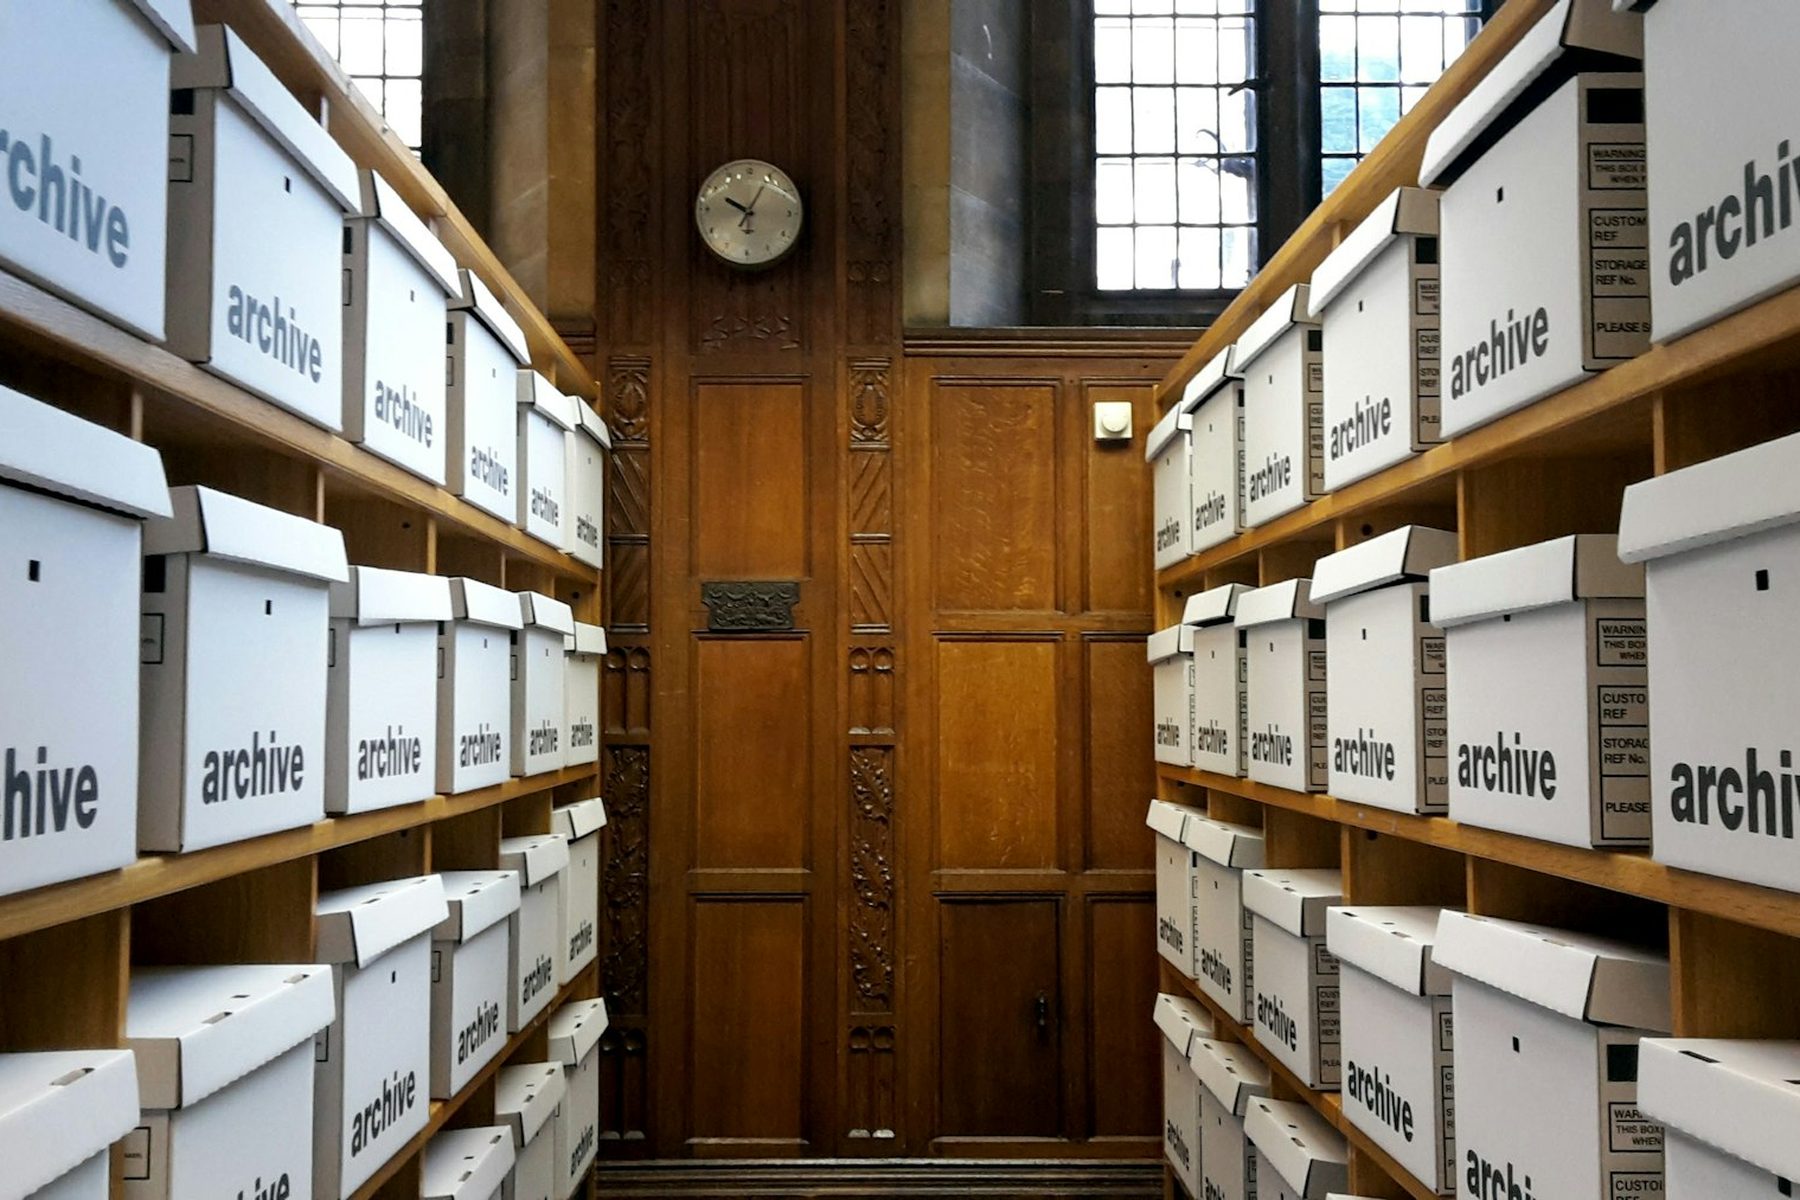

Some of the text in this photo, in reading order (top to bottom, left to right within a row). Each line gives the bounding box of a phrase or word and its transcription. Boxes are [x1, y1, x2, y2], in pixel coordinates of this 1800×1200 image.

[1595, 231, 1618, 241] REF
[1596, 275, 1618, 285] REF
[228, 284, 322, 384] archive
[1596, 322, 1640, 333] PLEASE
[1451, 307, 1550, 400] archive
[374, 379, 433, 450] archive
[1331, 395, 1392, 461] archive
[471, 445, 509, 497] archive
[1250, 452, 1291, 503] archive
[531, 486, 559, 527] archive
[1195, 490, 1226, 531] archive
[1156, 516, 1180, 551] archive
[530, 719, 559, 757] archive
[1198, 719, 1228, 756] archive
[1603, 709, 1627, 719] REF
[202, 731, 303, 805] archive
[358, 726, 420, 780] archive
[460, 723, 501, 767] archive
[1252, 724, 1292, 767] archive
[1335, 728, 1395, 782] archive
[1458, 731, 1557, 800] archive
[1604, 754, 1627, 764] REF
[2, 746, 98, 841] hive
[1606, 802, 1650, 813] PLEASE
[1671, 747, 1800, 839] archi
[522, 955, 553, 1006] archive
[1201, 948, 1232, 995] archive
[457, 1000, 500, 1065] archive
[1257, 990, 1297, 1052] archive
[352, 1070, 416, 1157] archive
[1348, 1060, 1414, 1144] archive
[1614, 1110, 1642, 1119] WAR
[1616, 1125, 1638, 1134] THIS
[1615, 1181, 1663, 1191] CUSTO
